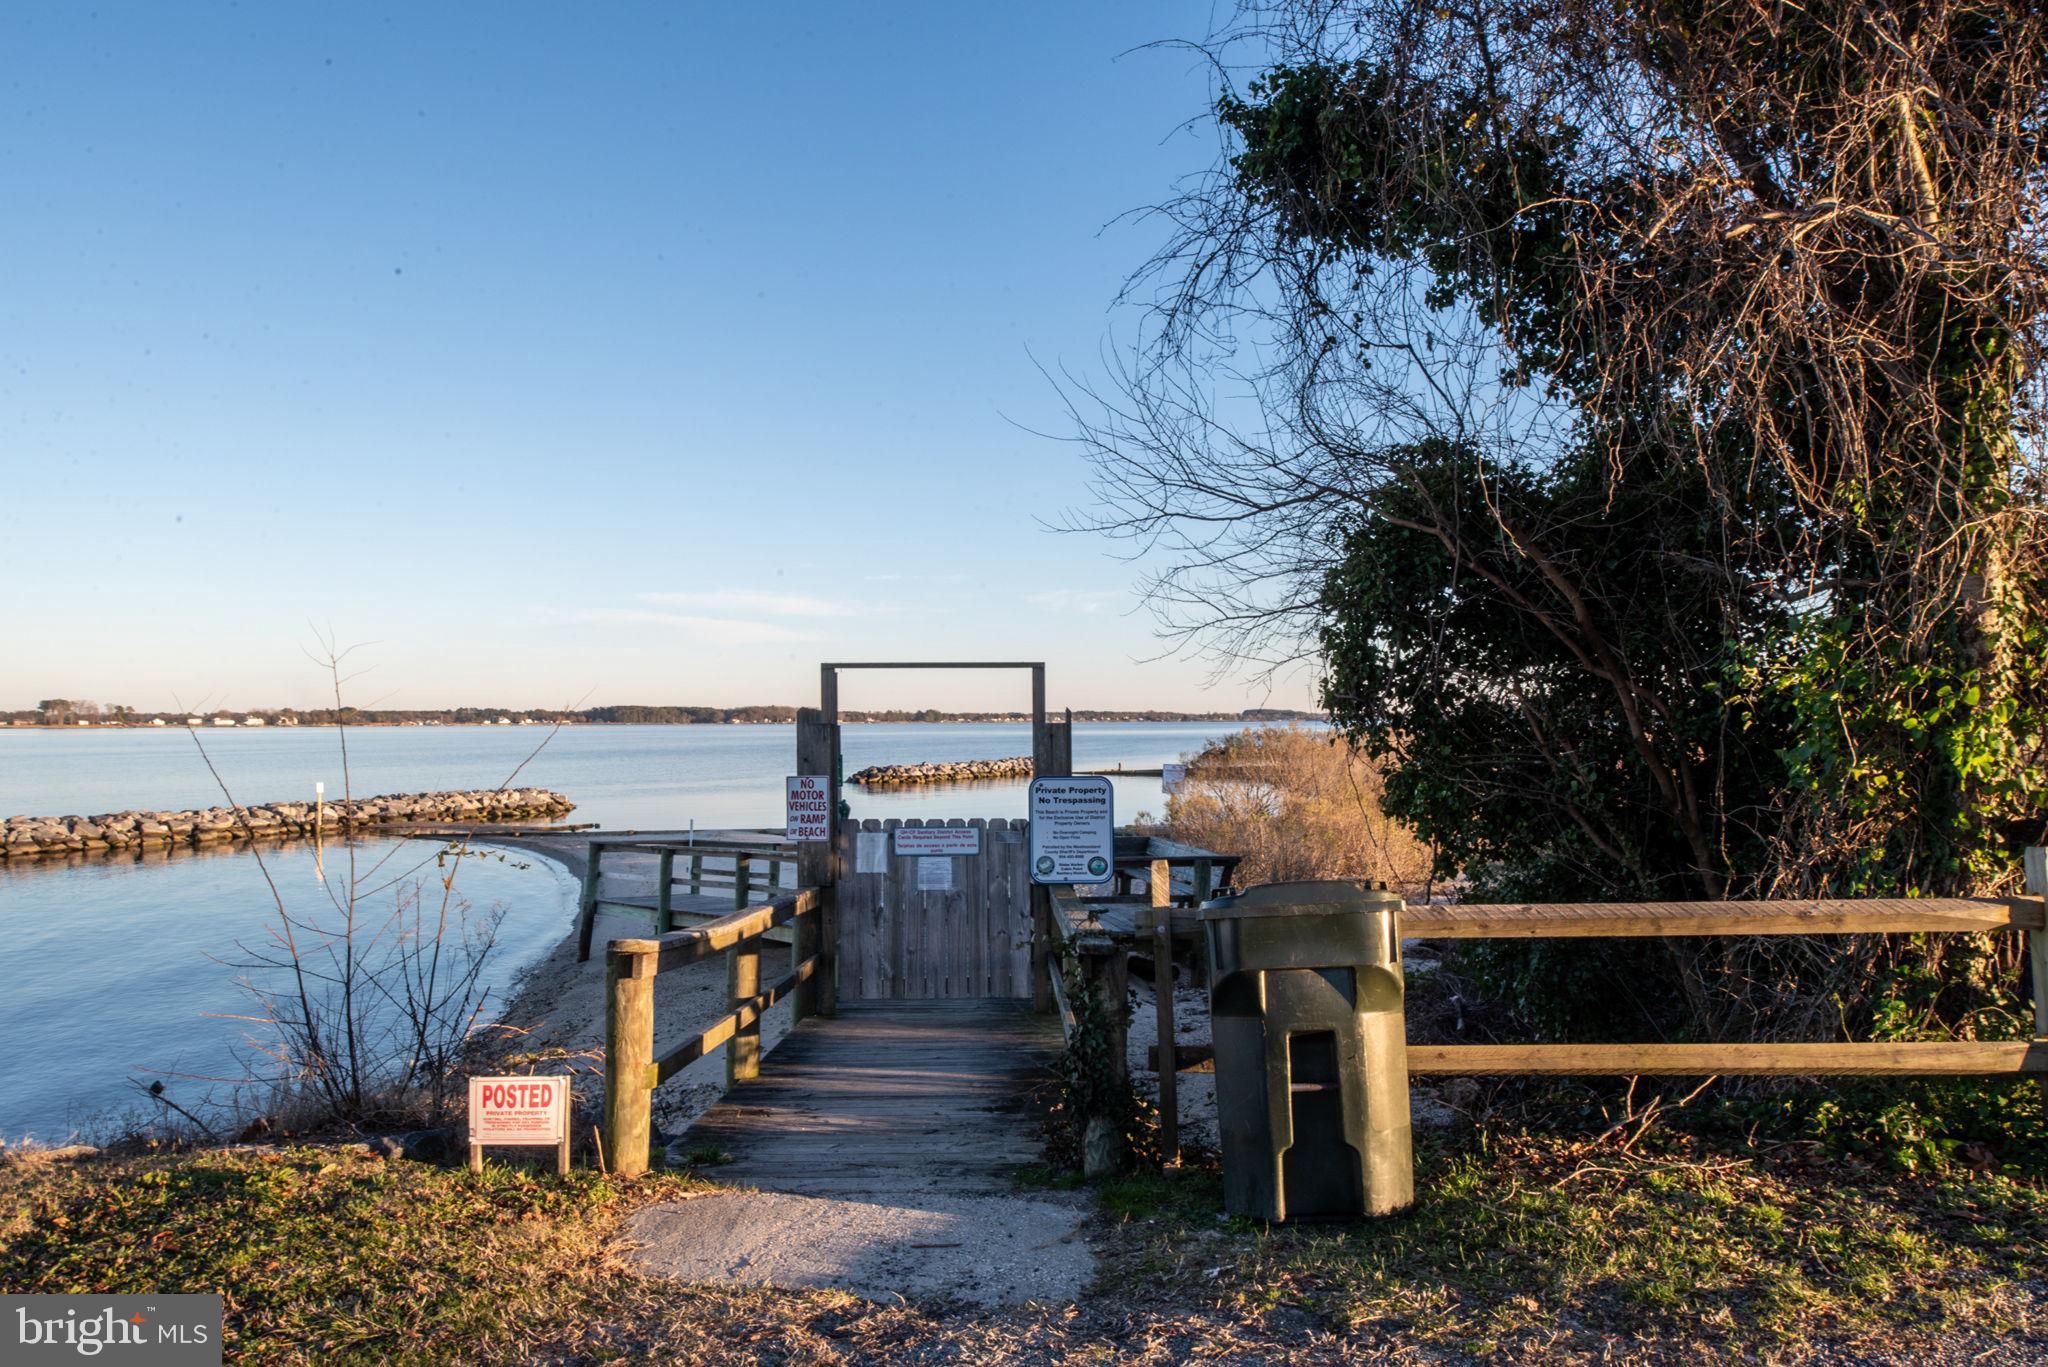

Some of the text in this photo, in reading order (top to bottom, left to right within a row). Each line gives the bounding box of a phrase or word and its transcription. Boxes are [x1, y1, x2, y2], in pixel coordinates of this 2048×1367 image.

[801, 779, 814, 789] NO
[792, 791, 824, 800] MOTOR
[1069, 787, 1106, 795] Property
[1053, 797, 1106, 805] Trespassing
[789, 802, 827, 811] VEHICLES
[800, 814, 826, 824] RAMP
[799, 827, 826, 836] BEACH
[482, 1084, 552, 1109] POSTED
